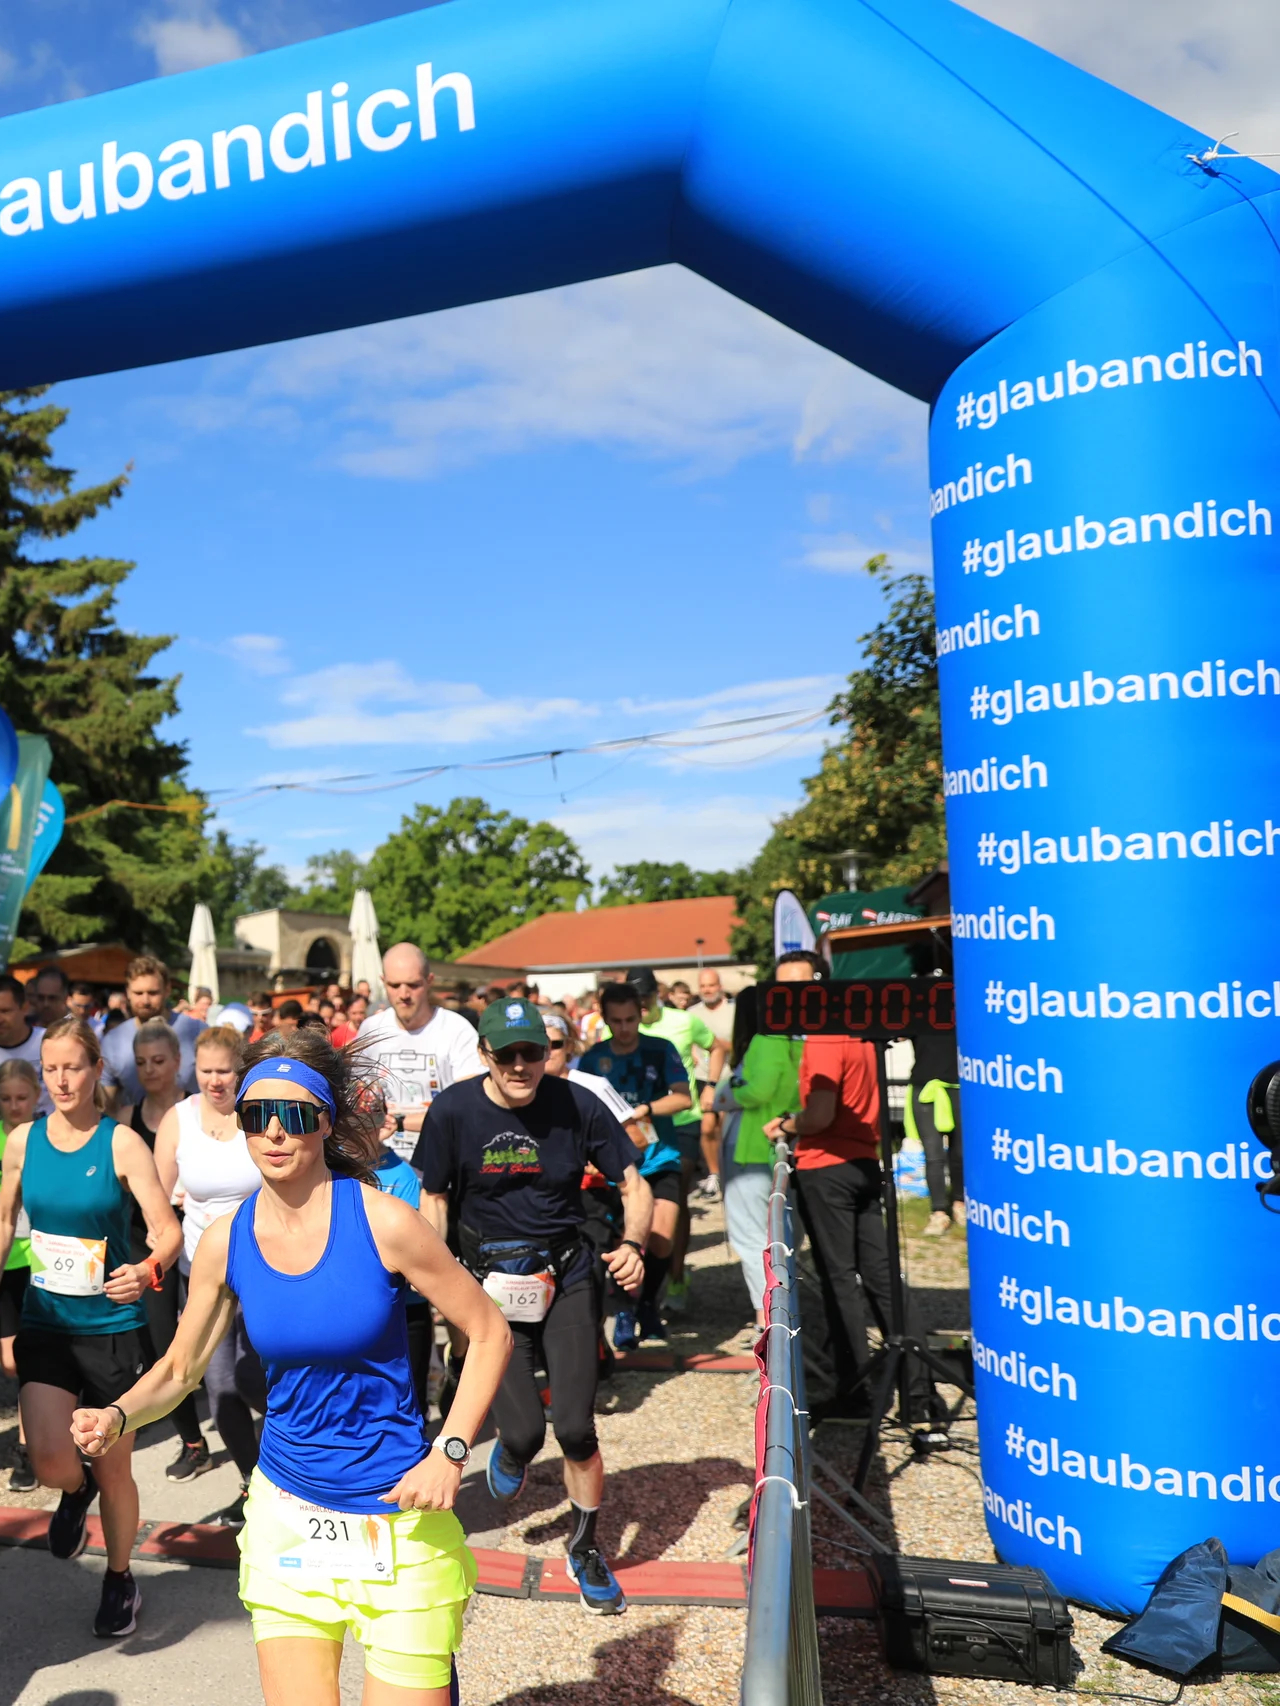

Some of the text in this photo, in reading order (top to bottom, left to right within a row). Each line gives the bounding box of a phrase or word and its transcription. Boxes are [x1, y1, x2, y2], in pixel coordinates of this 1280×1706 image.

[956, 340, 1263, 430] #glaubandich
[962, 499, 1272, 577] #glaubandich
[970, 659, 1280, 726] #glaubandich
[977, 819, 1280, 875] #glaubandich
[984, 979, 1280, 1025] #glaubandic
[53, 1256, 75, 1272] 69
[508, 1291, 538, 1305] 162
[998, 1275, 1280, 1342] #glaubandic
[308, 1517, 350, 1541] 231
